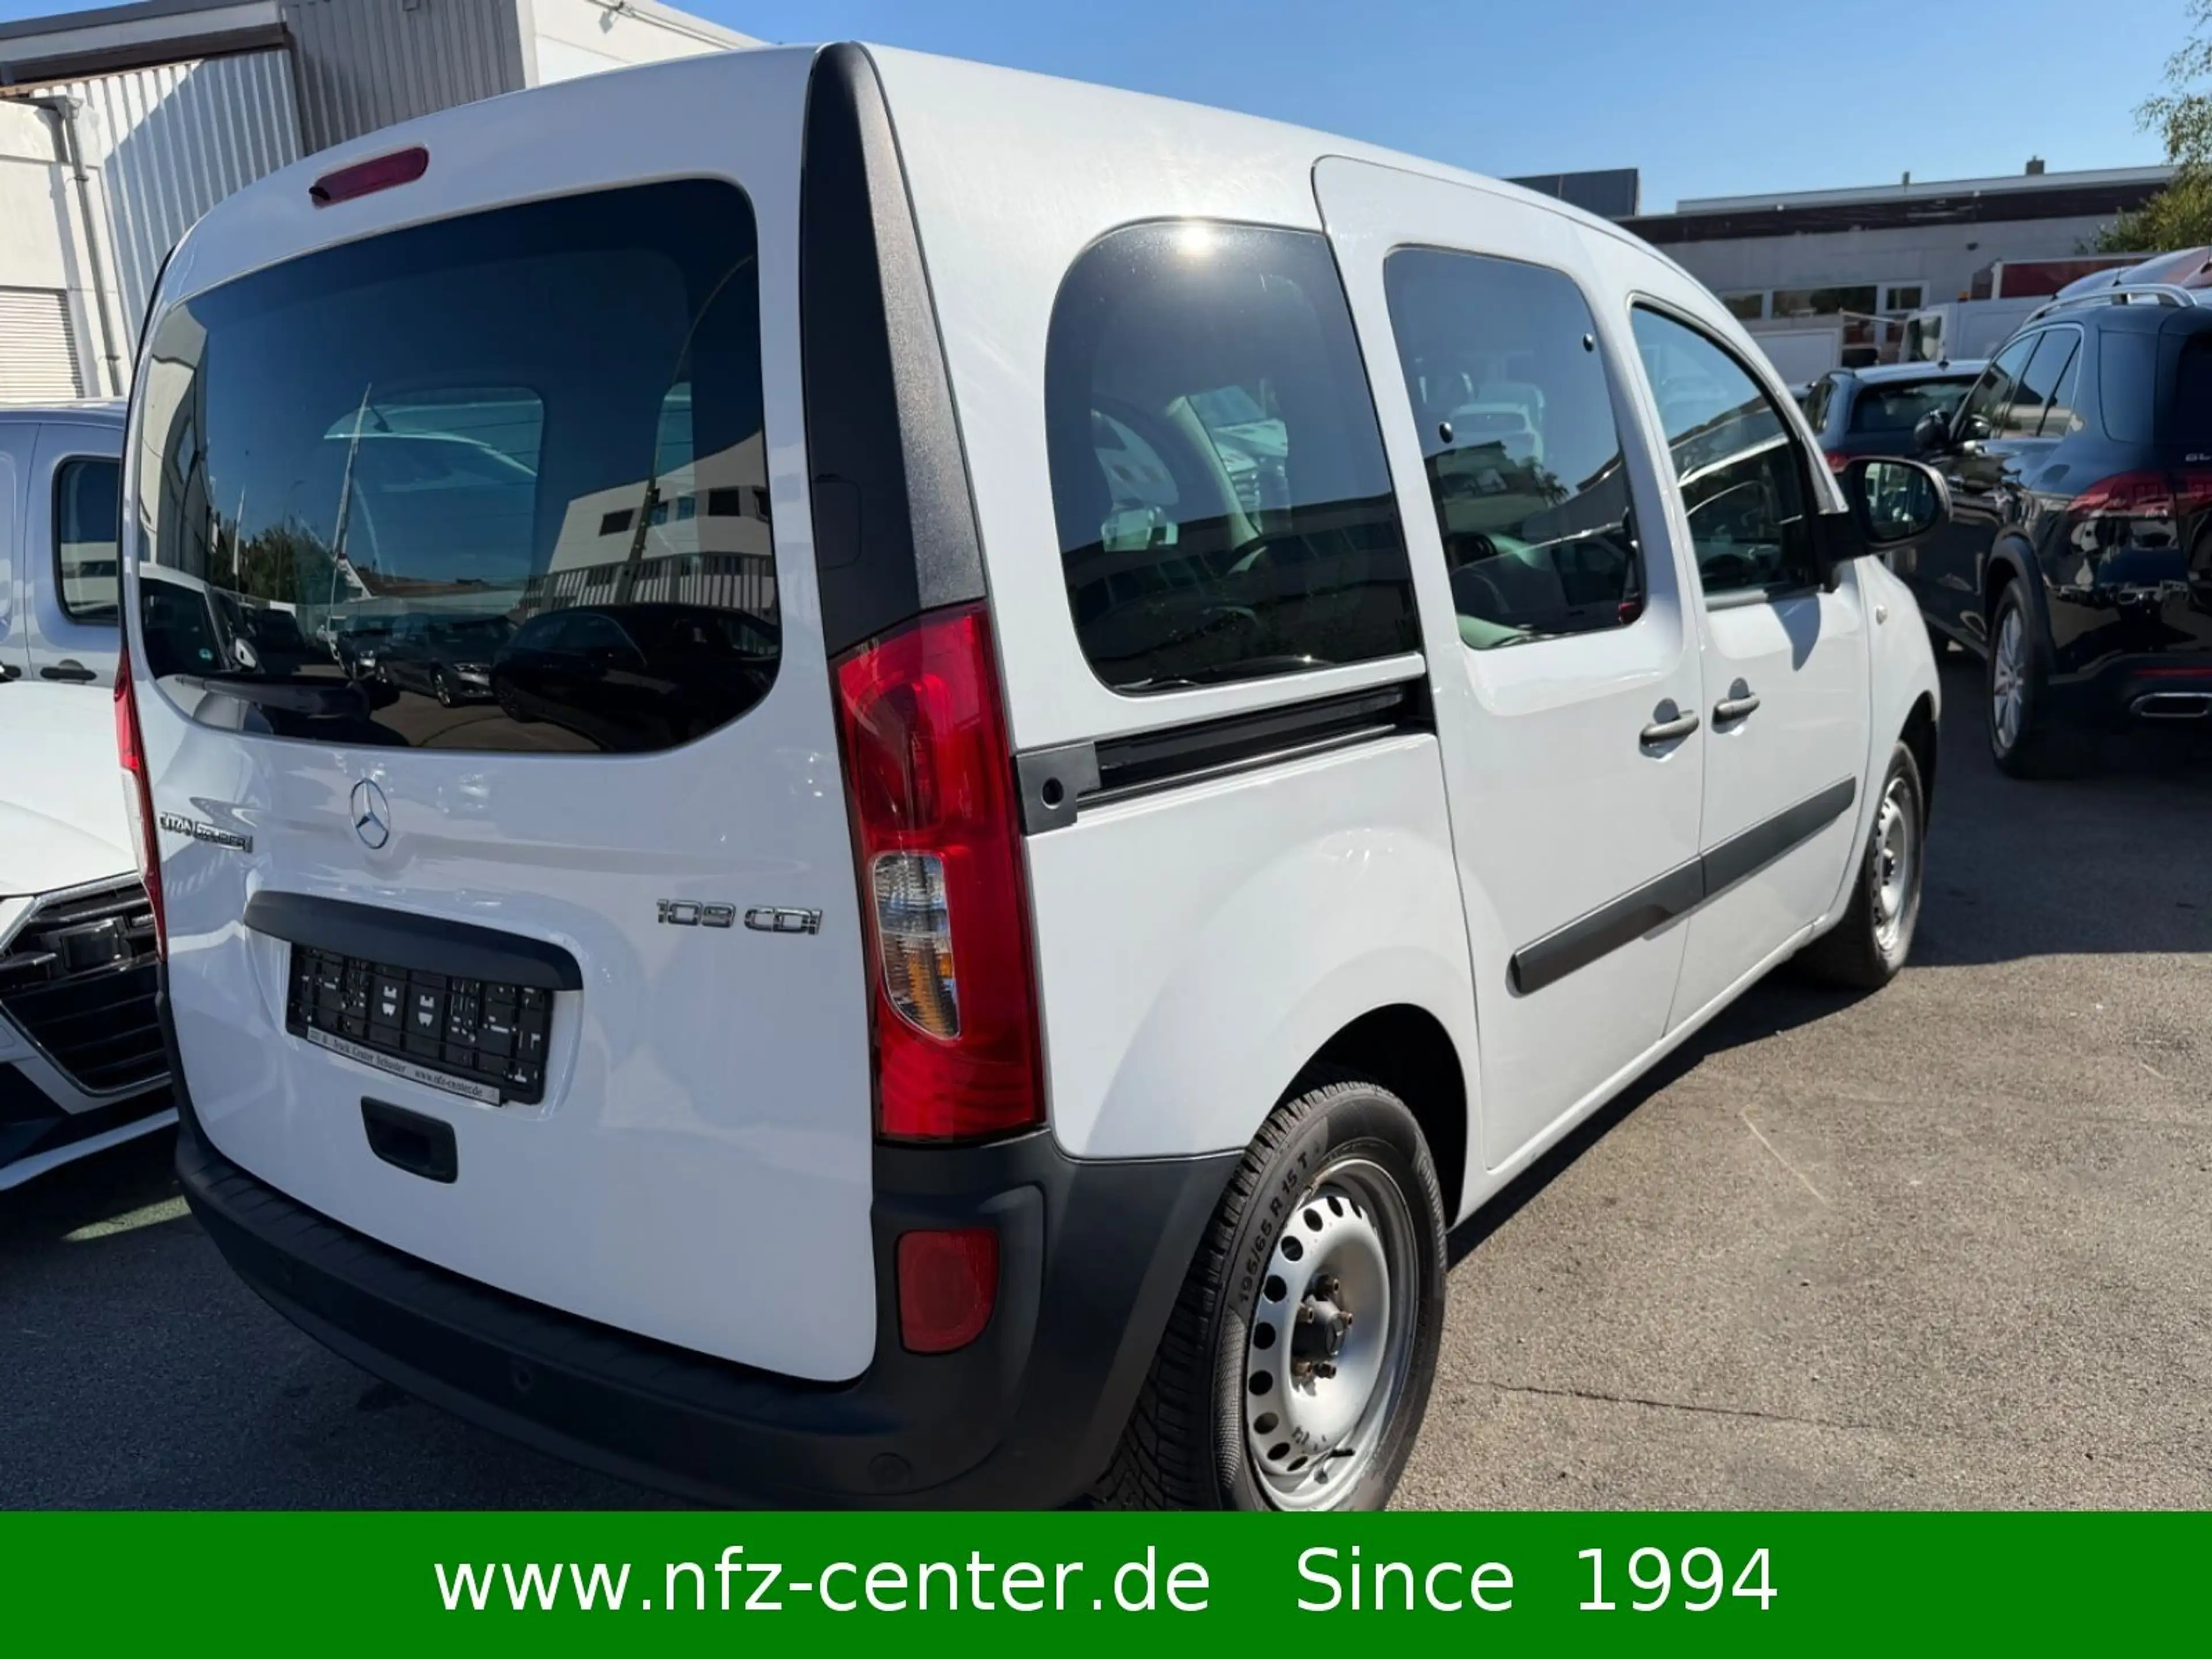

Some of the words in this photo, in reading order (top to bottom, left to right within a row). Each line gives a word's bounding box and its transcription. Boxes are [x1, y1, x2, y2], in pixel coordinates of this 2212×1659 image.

[657, 899, 736, 928] 109
[744, 905, 823, 935] CDI
[1270, 1197, 1284, 1217] R
[1282, 1172, 1298, 1194] 15
